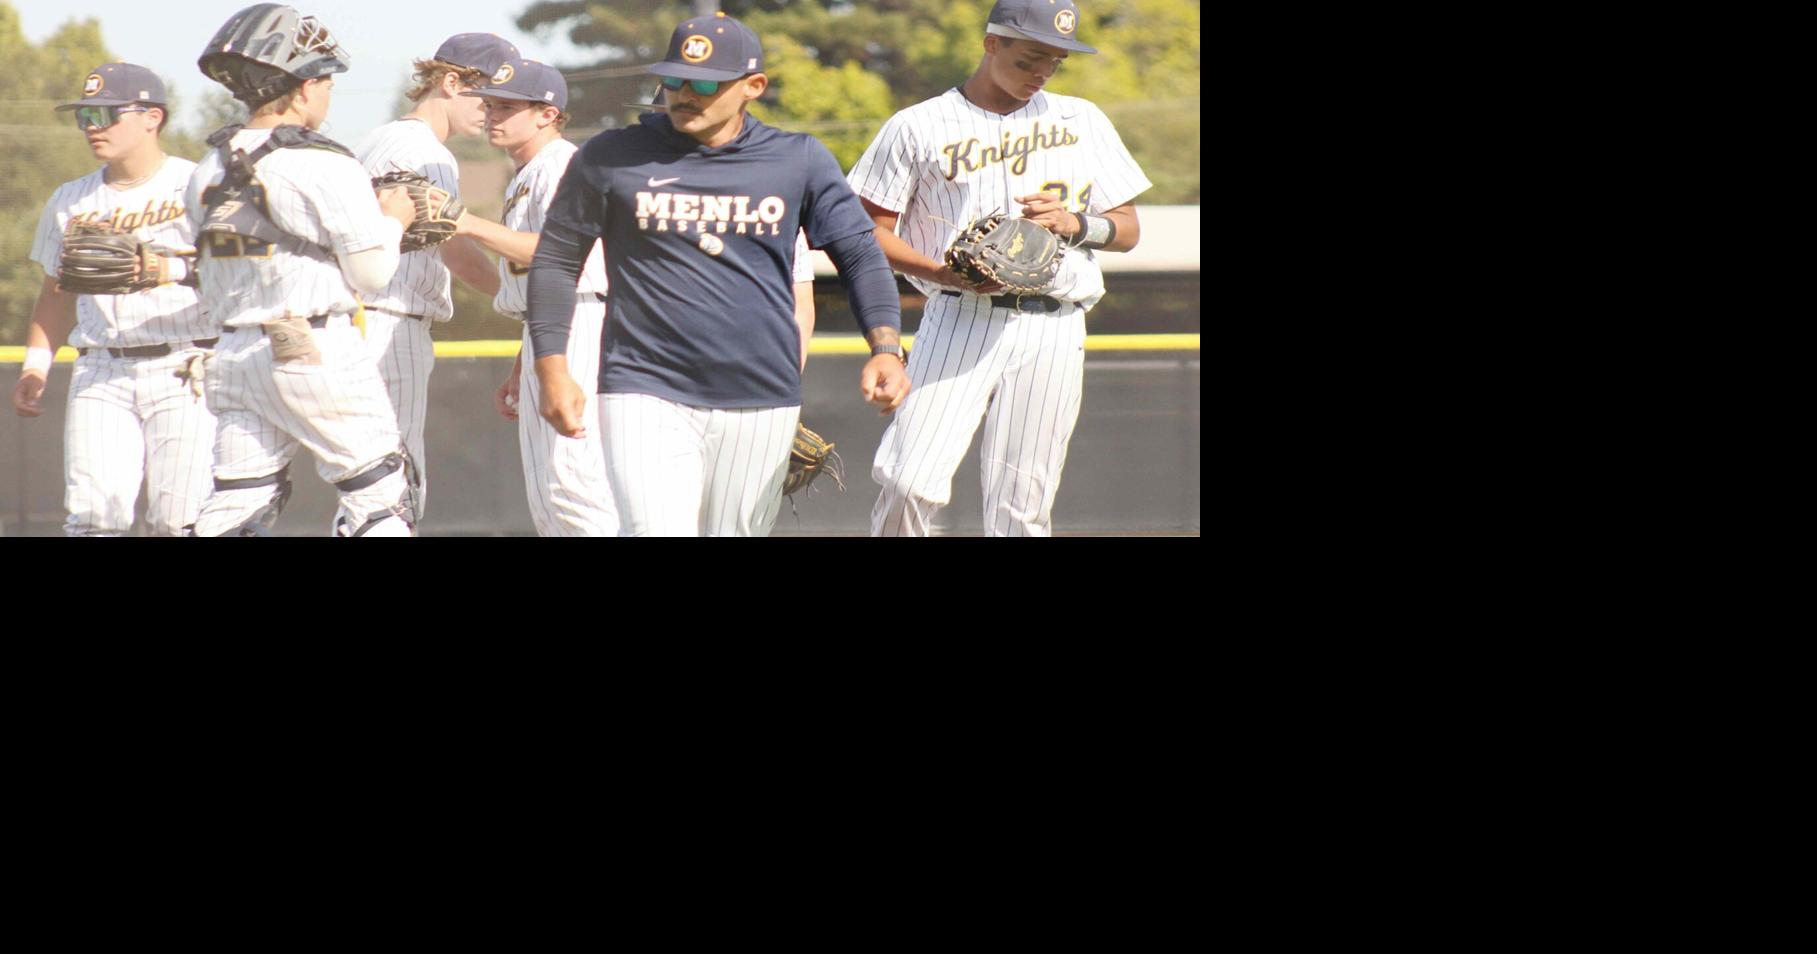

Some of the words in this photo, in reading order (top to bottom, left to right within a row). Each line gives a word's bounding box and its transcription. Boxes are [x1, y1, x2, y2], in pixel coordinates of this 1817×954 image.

[685, 39, 707, 57] M
[943, 121, 1079, 181] Knights
[635, 191, 785, 224] MENLO
[638, 218, 781, 236] BASEBALL
